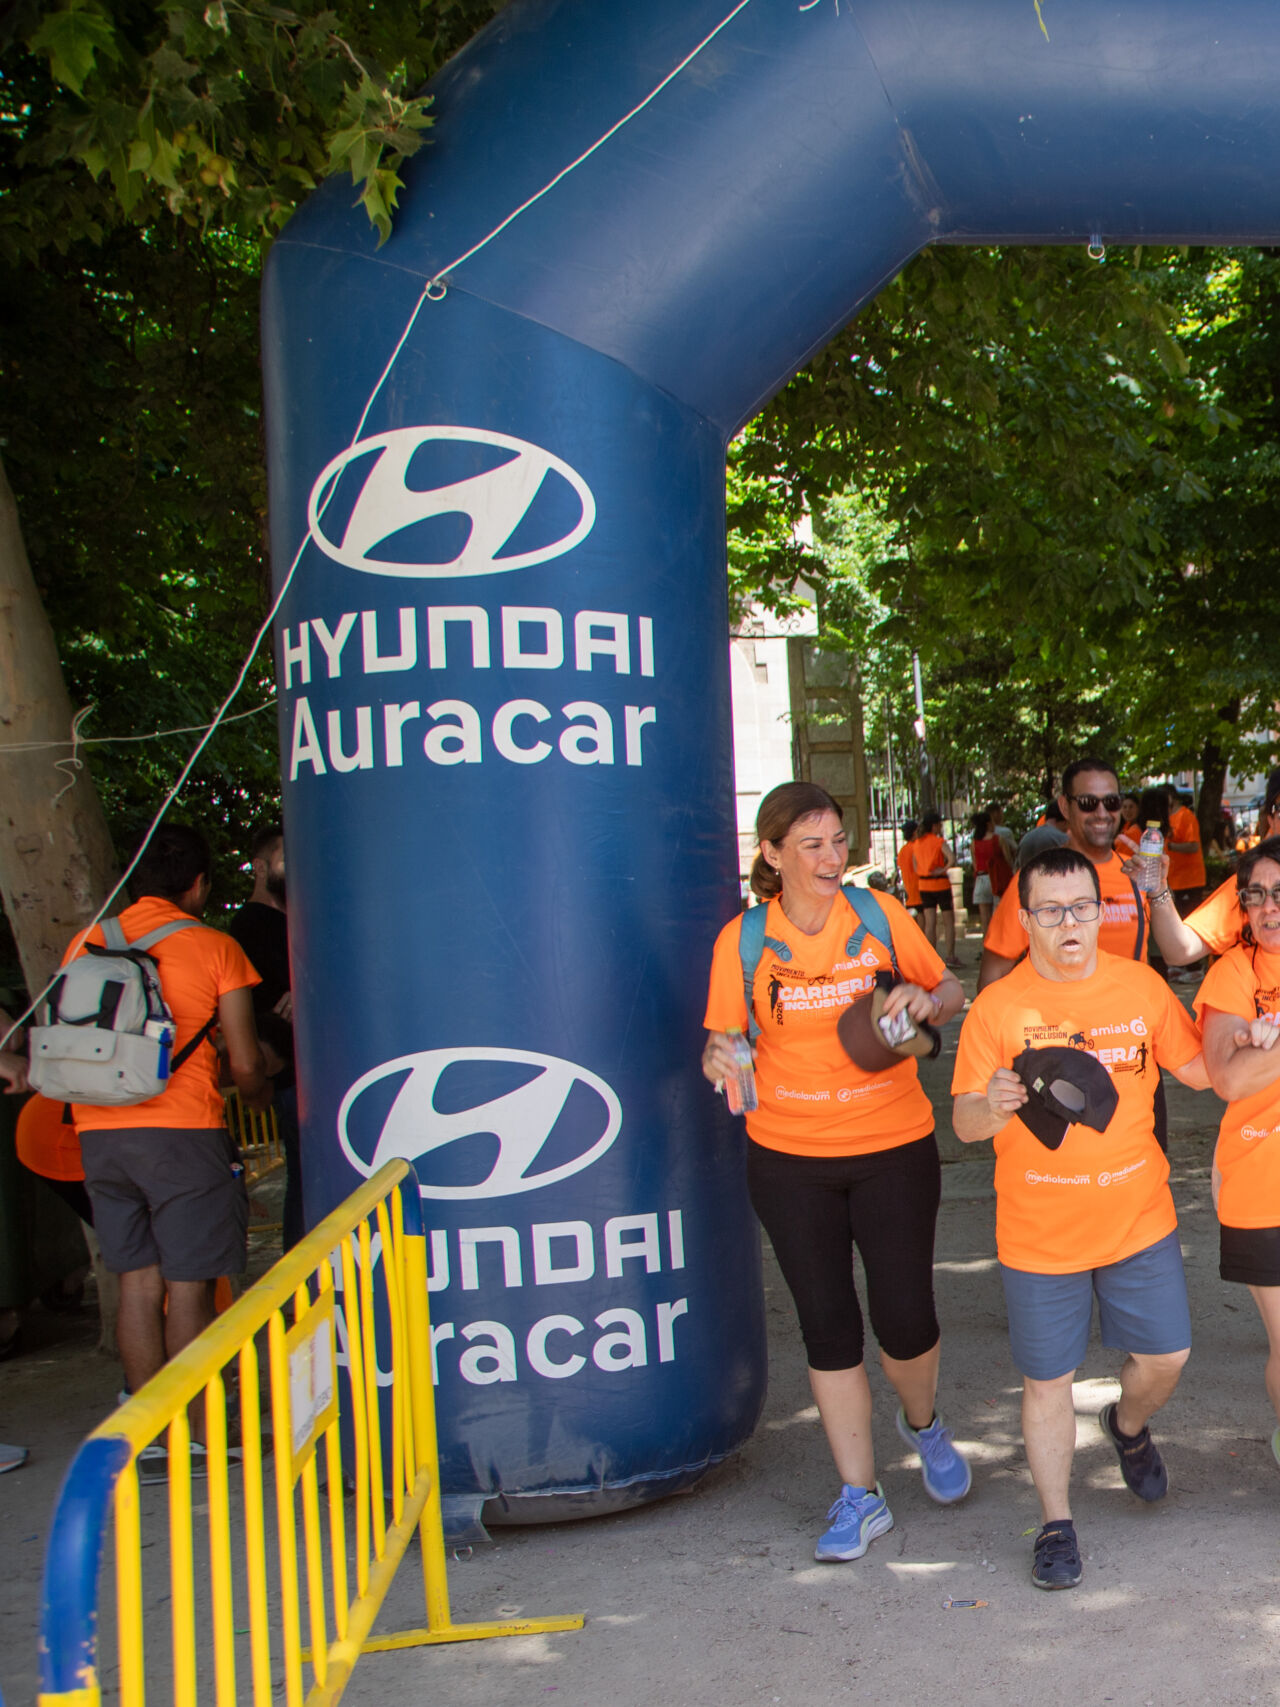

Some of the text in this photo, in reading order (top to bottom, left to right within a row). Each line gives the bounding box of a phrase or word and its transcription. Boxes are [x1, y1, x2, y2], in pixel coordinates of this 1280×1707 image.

[283, 605, 655, 690] HYUNDAI
[290, 697, 657, 782] Auracar
[778, 975, 876, 1001] CARRERA
[783, 995, 854, 1011] INCLUSIVA
[1023, 1025, 1059, 1033] MOVIMIENTO
[1090, 1022, 1130, 1036] amiab
[1026, 1170, 1091, 1185] mediolanum
[334, 1298, 688, 1387] racar
